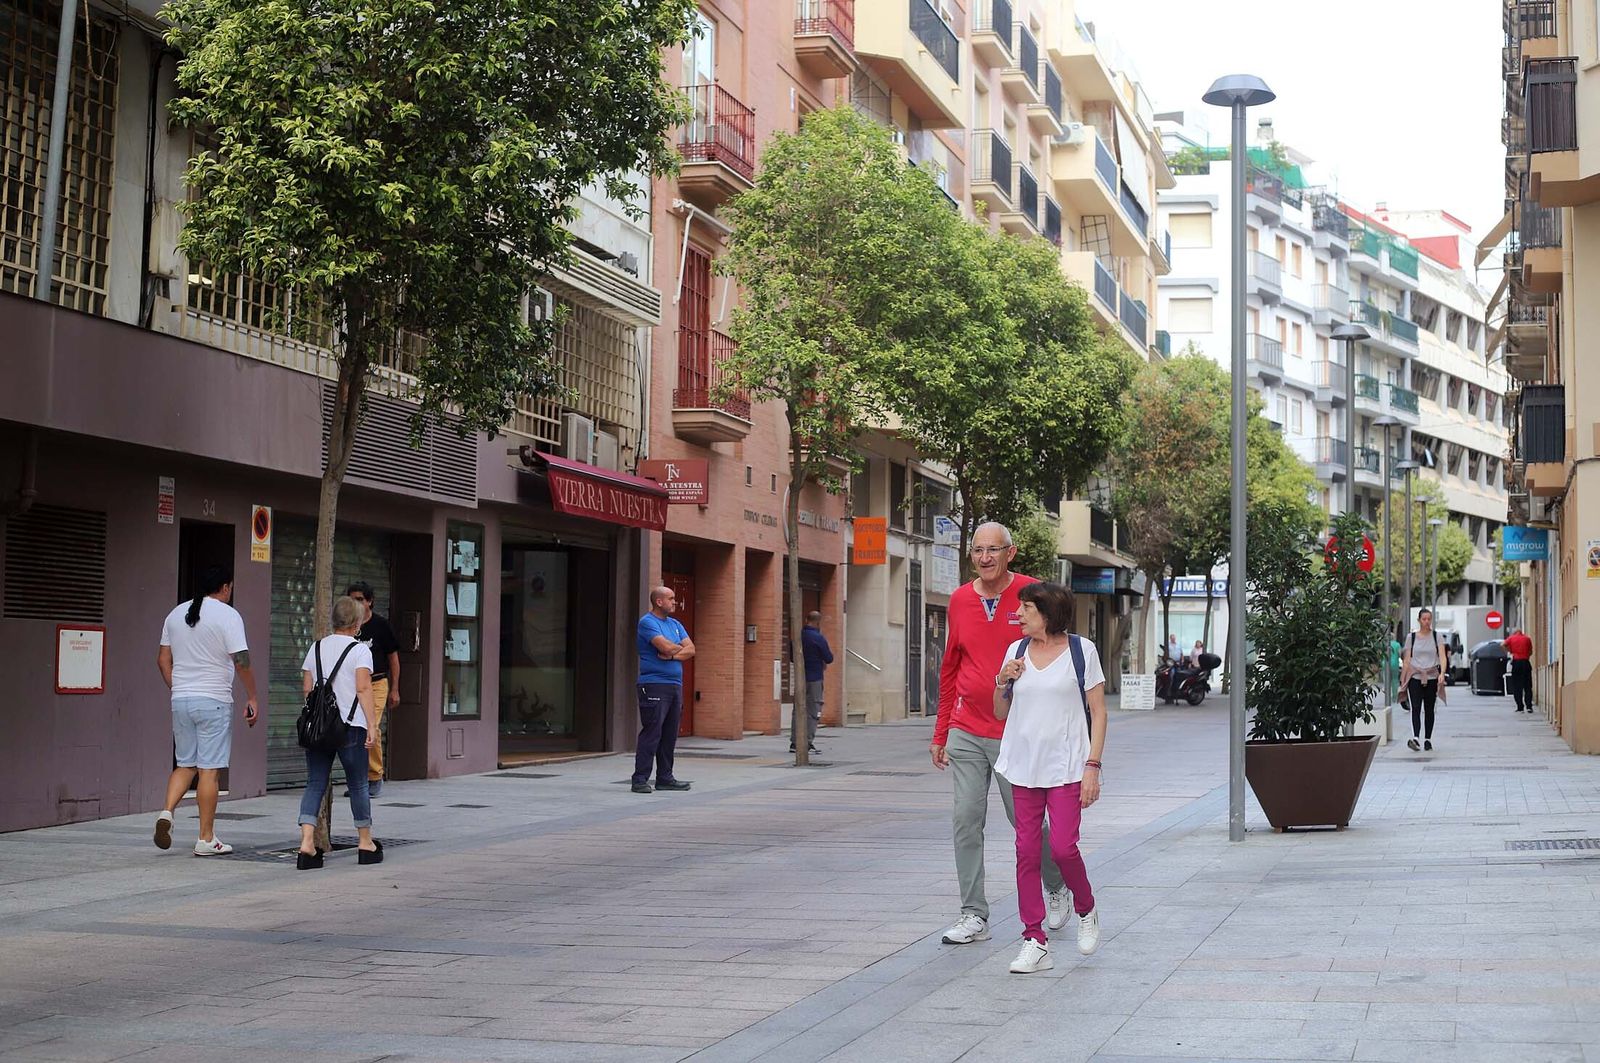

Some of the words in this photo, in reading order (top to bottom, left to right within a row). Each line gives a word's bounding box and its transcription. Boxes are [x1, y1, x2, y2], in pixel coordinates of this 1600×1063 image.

[555, 476, 605, 512] TIERRA
[203, 499, 215, 516] 34
[1506, 542, 1545, 551] migrow
[1166, 581, 1227, 592] JIMEO
